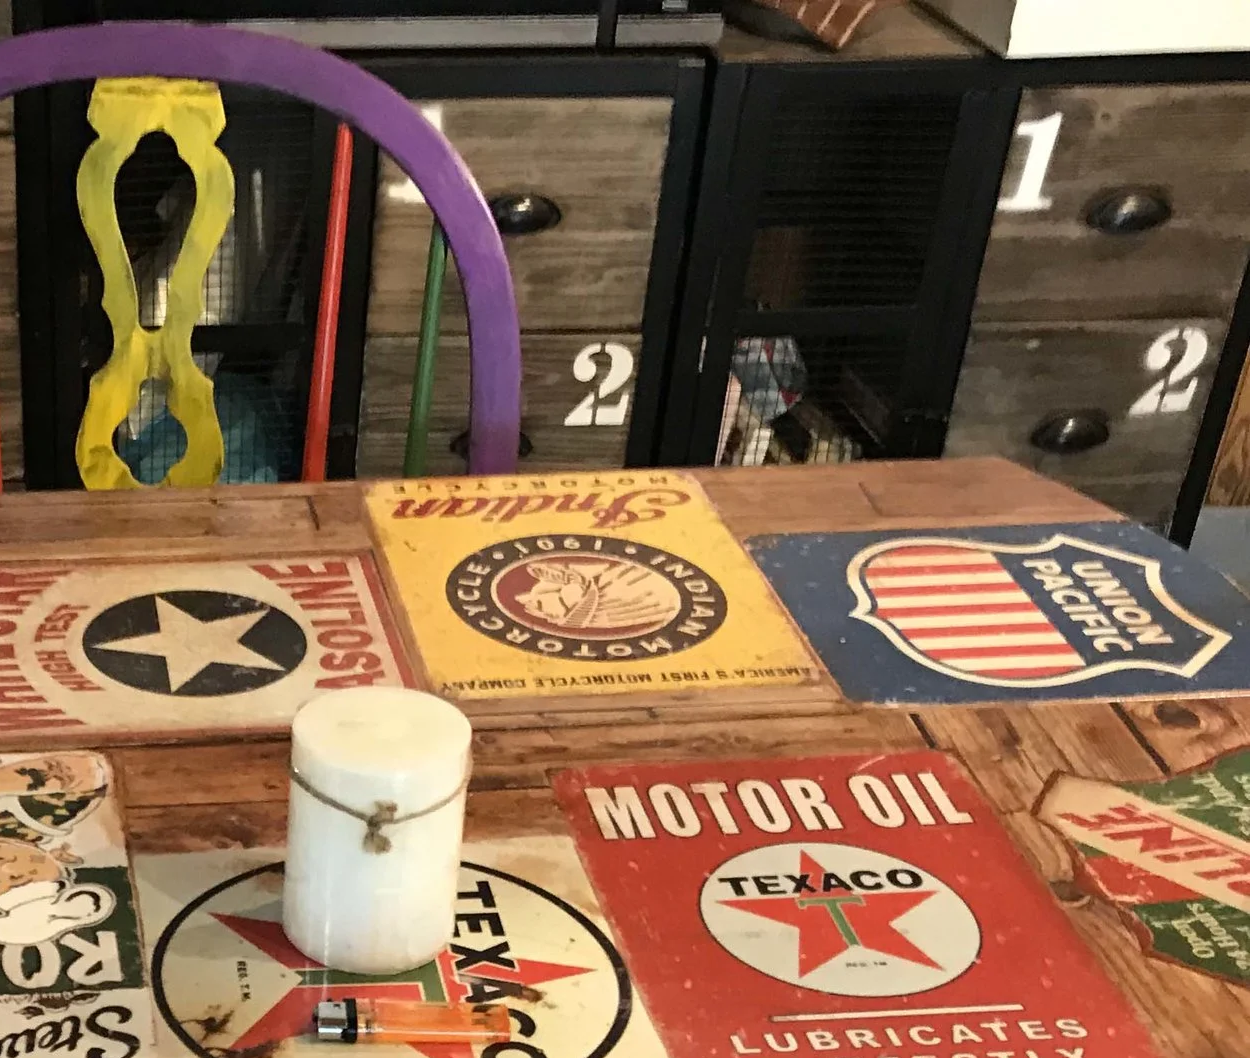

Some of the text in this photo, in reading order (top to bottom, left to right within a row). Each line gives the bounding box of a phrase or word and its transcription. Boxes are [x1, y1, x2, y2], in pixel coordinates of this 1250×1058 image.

[995, 111, 1066, 211] 1
[564, 342, 634, 427] 2
[1129, 327, 1211, 416] 2
[391, 475, 669, 496] MOTORCYCLE
[391, 488, 691, 529] Indian
[514, 538, 603, 559] 1901
[249, 561, 386, 689] ASOLINE
[456, 552, 717, 658] INDIAN MOTORCYCLE
[1022, 558, 1135, 654] PACIFIC
[1072, 560, 1175, 648] UNION
[34, 603, 106, 692] HIGH TEST
[440, 665, 812, 693] AMERICA'S FIRST MOTORCYCLE COMPANY
[584, 771, 974, 841] MOTOR OIL
[717, 867, 924, 897] TEXACO
[1171, 919, 1216, 958] Open
[730, 1018, 1089, 1056] LUBRICATES
